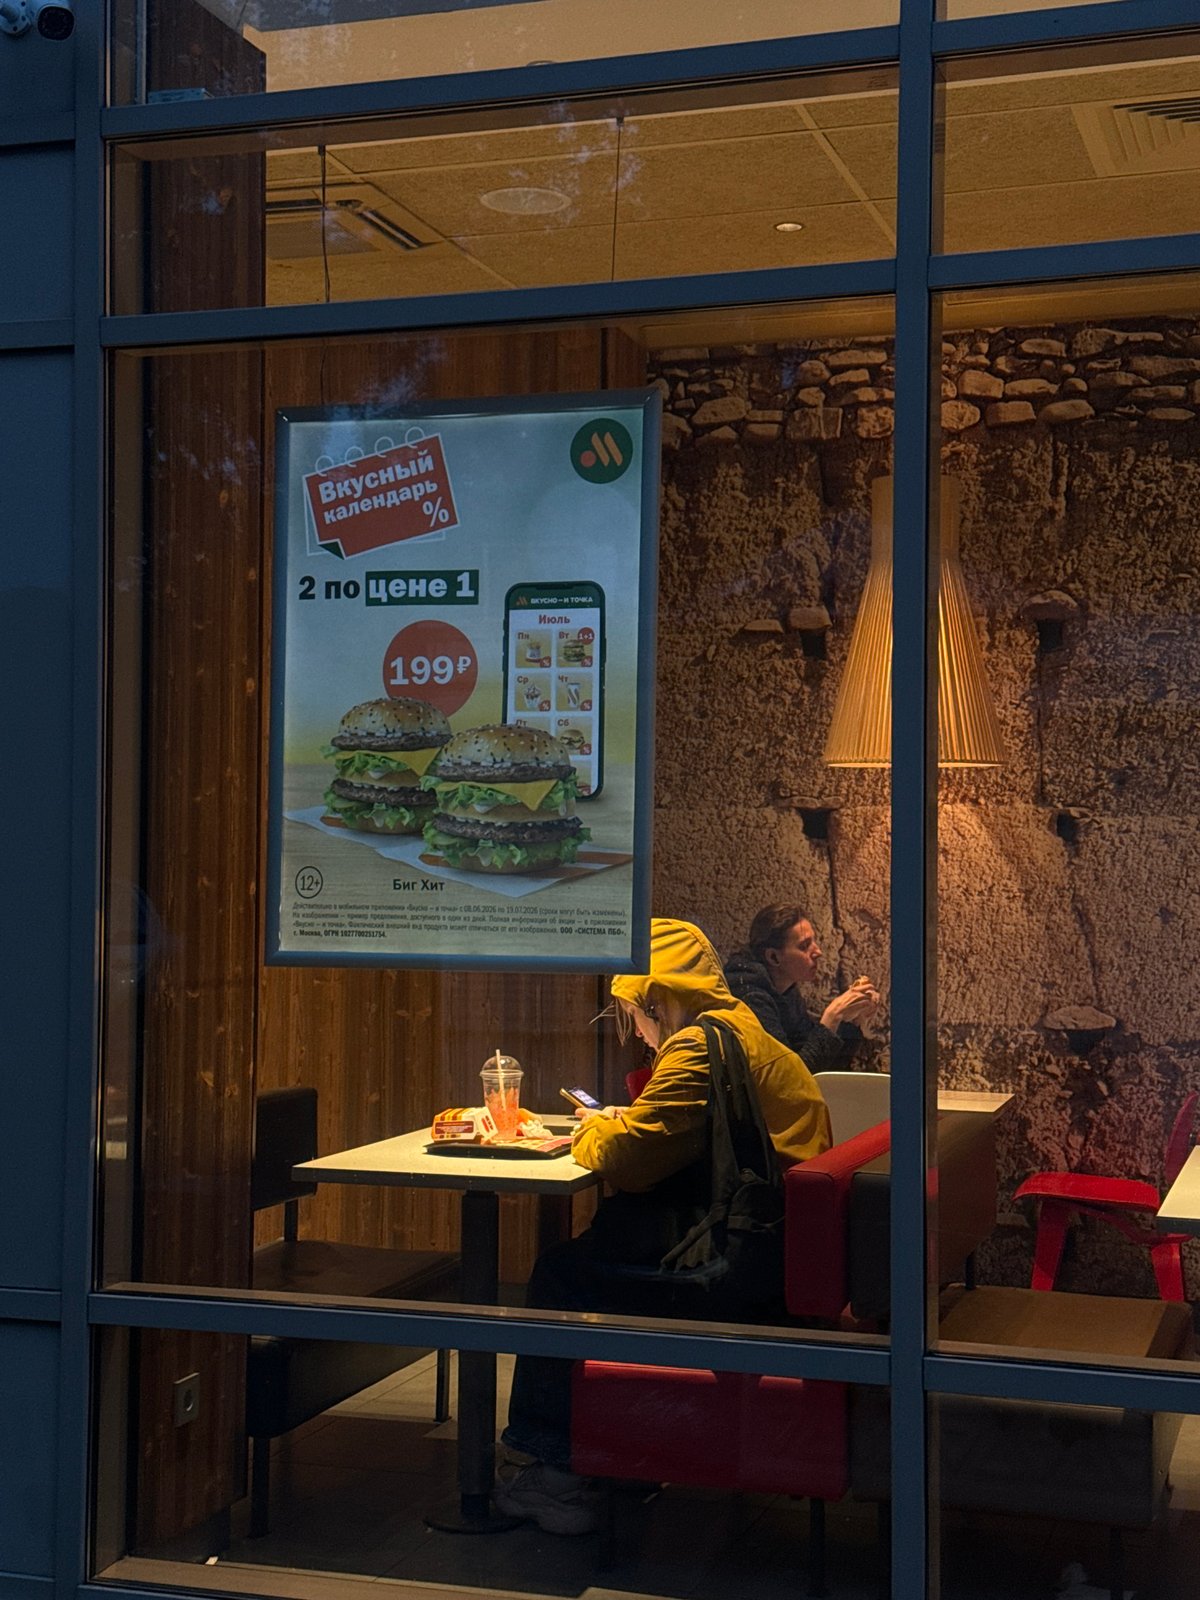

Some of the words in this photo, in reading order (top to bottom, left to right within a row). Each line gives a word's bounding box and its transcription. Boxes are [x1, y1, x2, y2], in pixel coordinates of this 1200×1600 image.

[318, 449, 435, 505] Вкусный
[323, 479, 439, 525] календарь
[422, 496, 450, 528] %
[299, 575, 316, 600] 2
[325, 580, 361, 600] по
[369, 577, 448, 603] цене
[456, 571, 475, 597] 1
[538, 614, 571, 625] Июль
[517, 632, 530, 641] Пн
[558, 631, 570, 640] Вт
[517, 675, 529, 685] Ср
[558, 675, 569, 683] Чт
[557, 719, 570, 727] Сб
[300, 875, 321, 891] 12+
[393, 878, 417, 891] Биг
[421, 879, 446, 892] Хит
